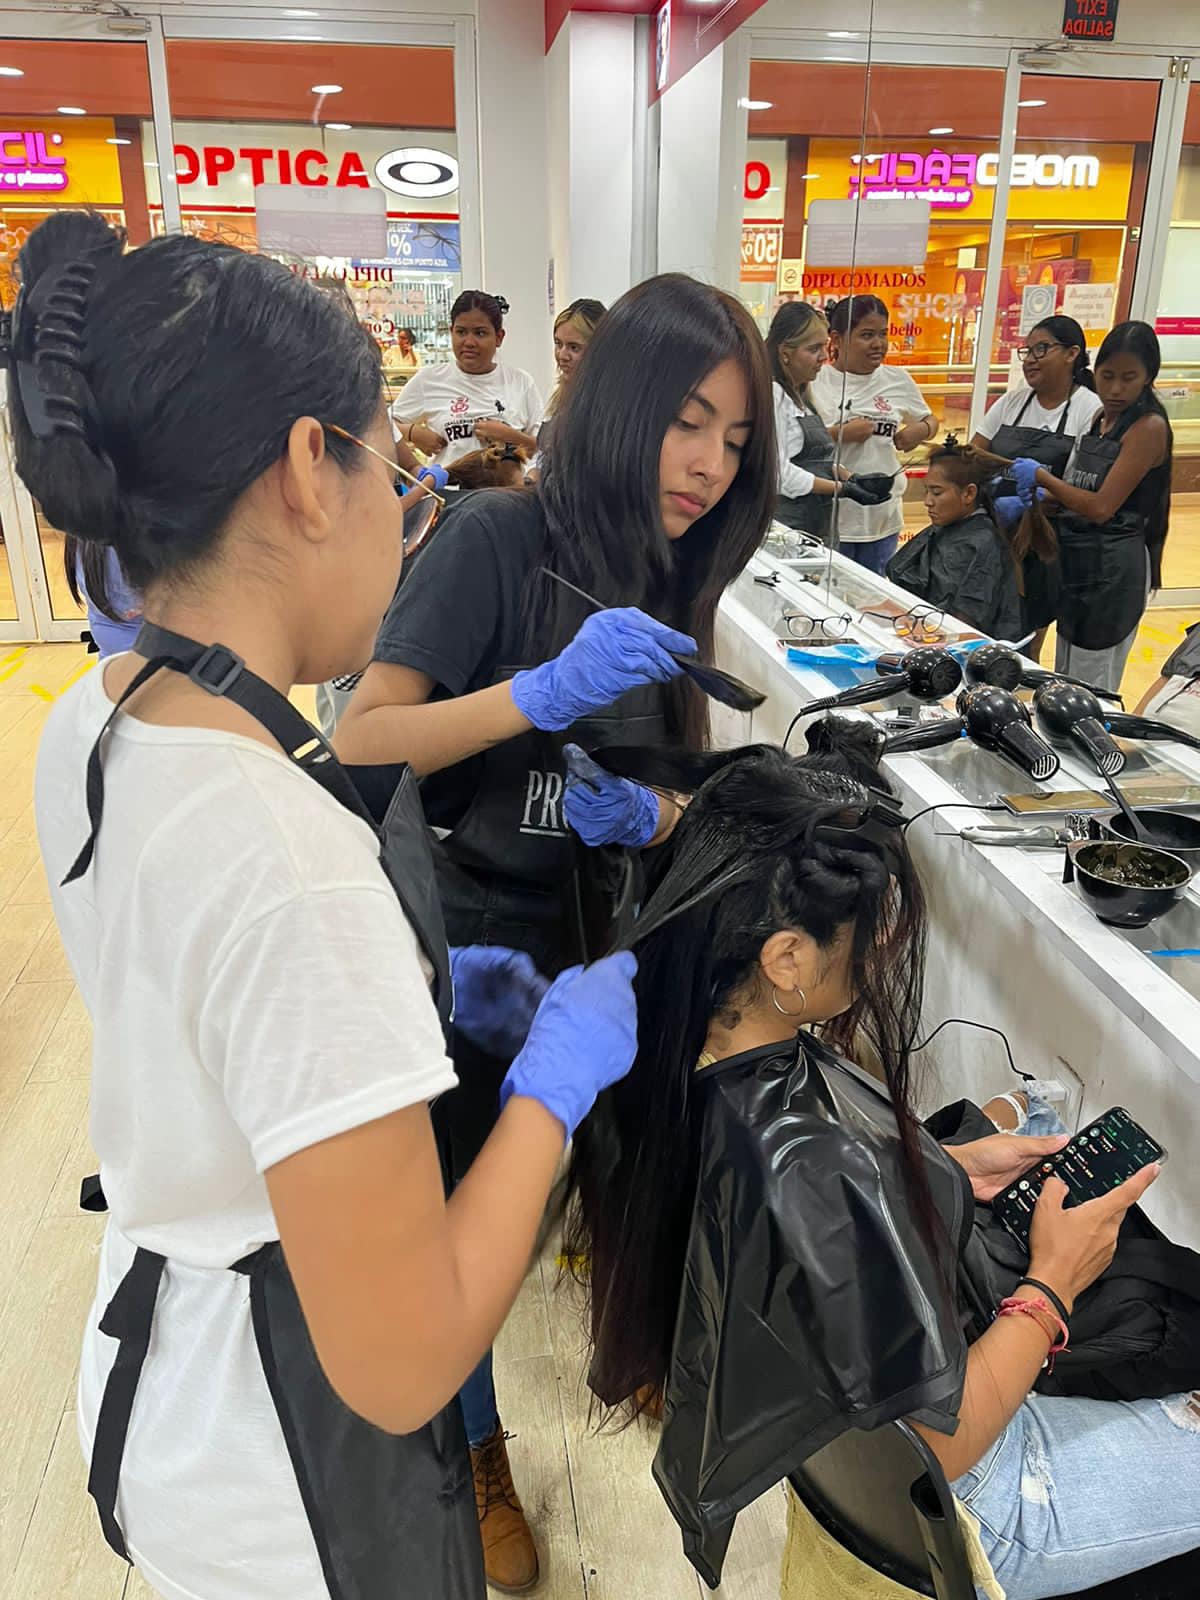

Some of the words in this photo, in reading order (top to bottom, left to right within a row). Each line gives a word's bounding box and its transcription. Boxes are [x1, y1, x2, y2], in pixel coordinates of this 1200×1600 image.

[173, 143, 371, 188] OPTICA
[888, 322, 922, 336] bello
[445, 424, 473, 442] PRL
[520, 769, 569, 829] PR
